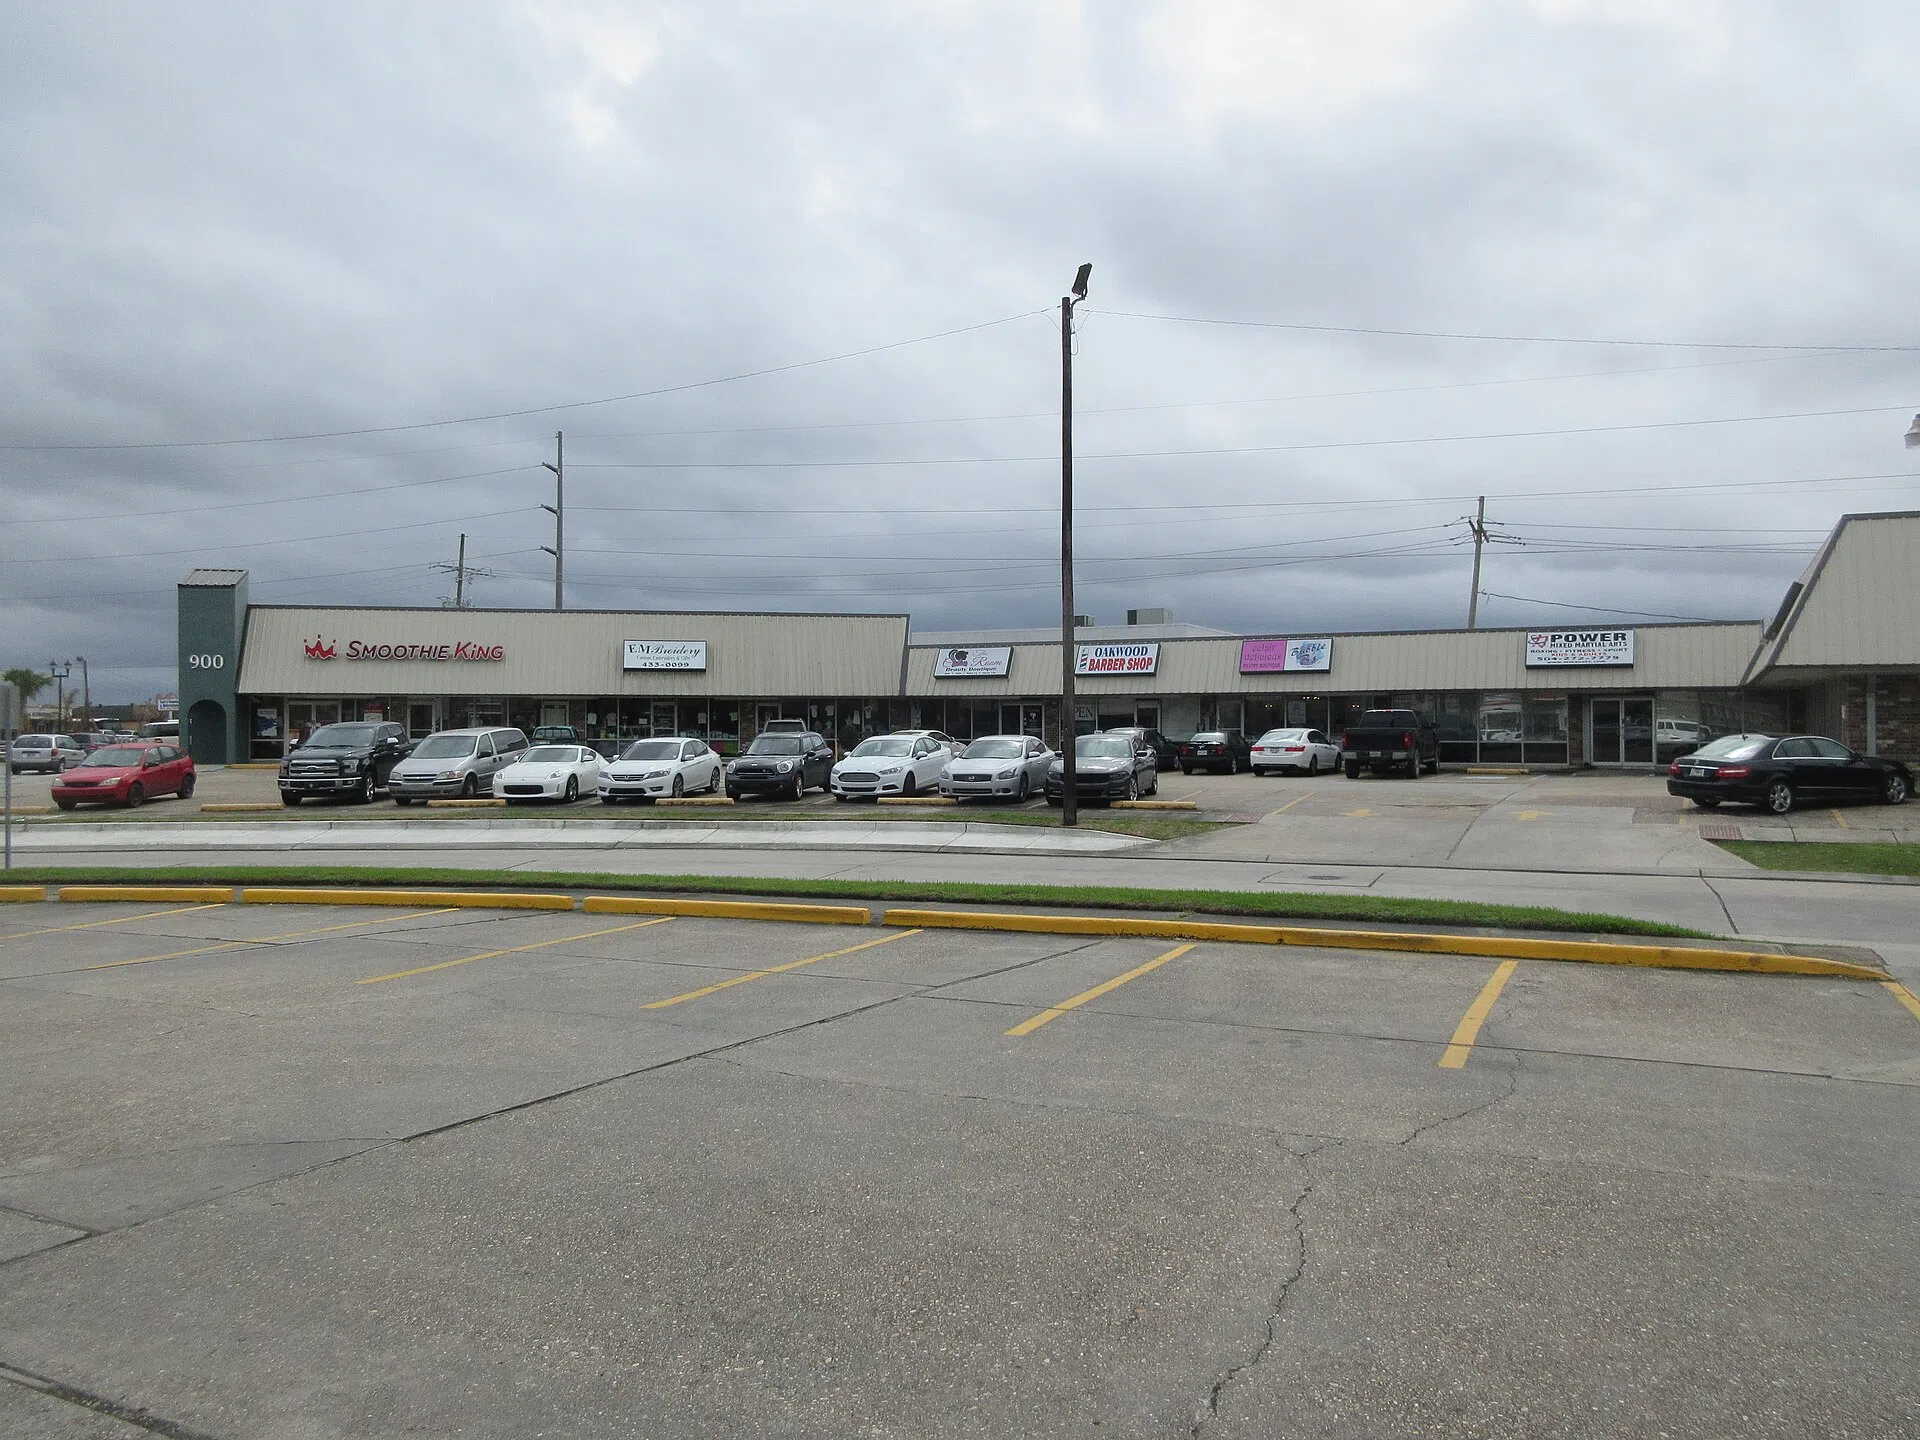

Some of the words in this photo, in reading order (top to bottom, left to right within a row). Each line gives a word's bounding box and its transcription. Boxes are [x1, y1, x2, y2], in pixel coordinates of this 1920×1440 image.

[1550, 632, 1627, 642] POWER
[346, 640, 450, 660] SMOOTHIE
[1094, 646, 1148, 657] OAKWOOD
[1290, 642, 1326, 657] Bubble
[190, 654, 224, 669] 900
[971, 656, 1002, 667] Room
[1088, 658, 1126, 671] BARBER
[1127, 657, 1153, 671] SHOP
[1074, 706, 1094, 718] PEN
